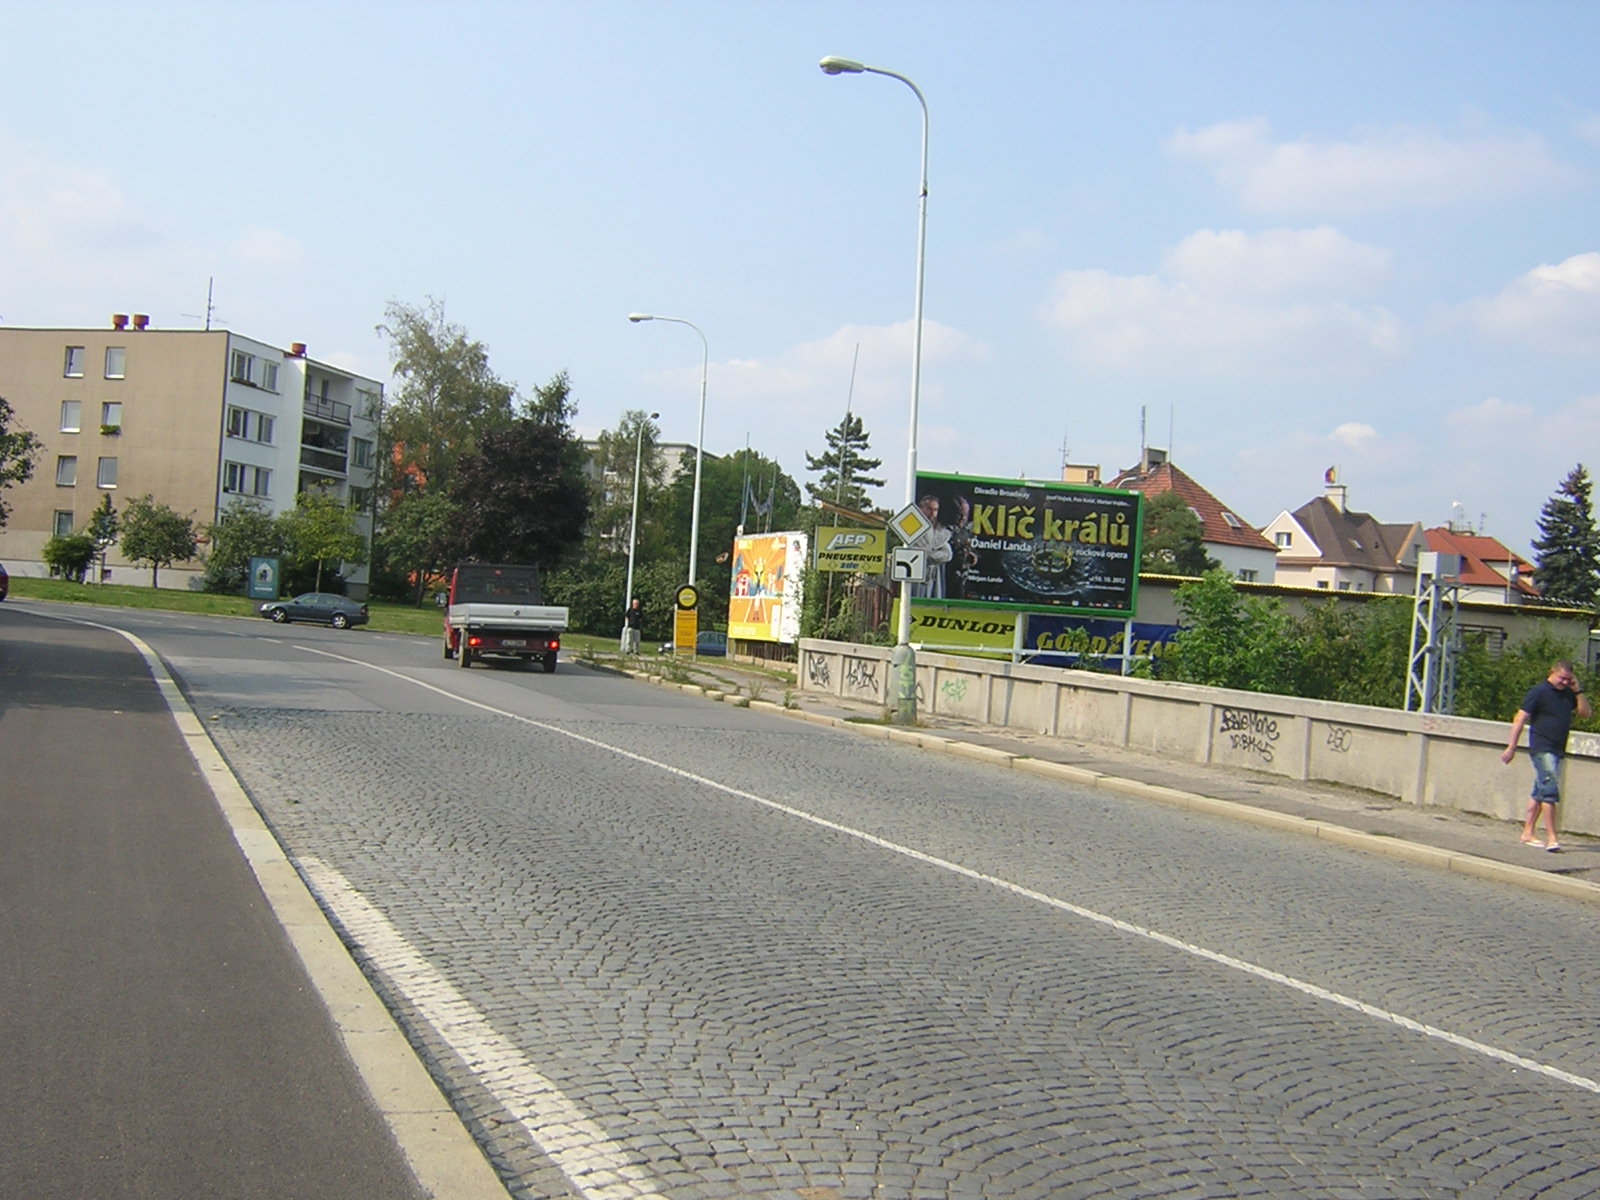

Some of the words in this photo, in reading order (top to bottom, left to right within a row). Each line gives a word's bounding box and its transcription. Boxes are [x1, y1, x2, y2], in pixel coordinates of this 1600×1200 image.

[974, 486, 998, 496] Divadlo
[999, 489, 1031, 500] Broadway
[972, 503, 1036, 540] Klíč
[1042, 508, 1130, 547] králů
[825, 533, 867, 550] AFP
[970, 538, 1002, 550] Daniel
[1003, 541, 1032, 552] Landa
[818, 552, 883, 562] PNEUSERVIS
[1075, 549, 1106, 558] rocková
[1106, 551, 1128, 560] opera
[919, 615, 1015, 635] DUNLOP
